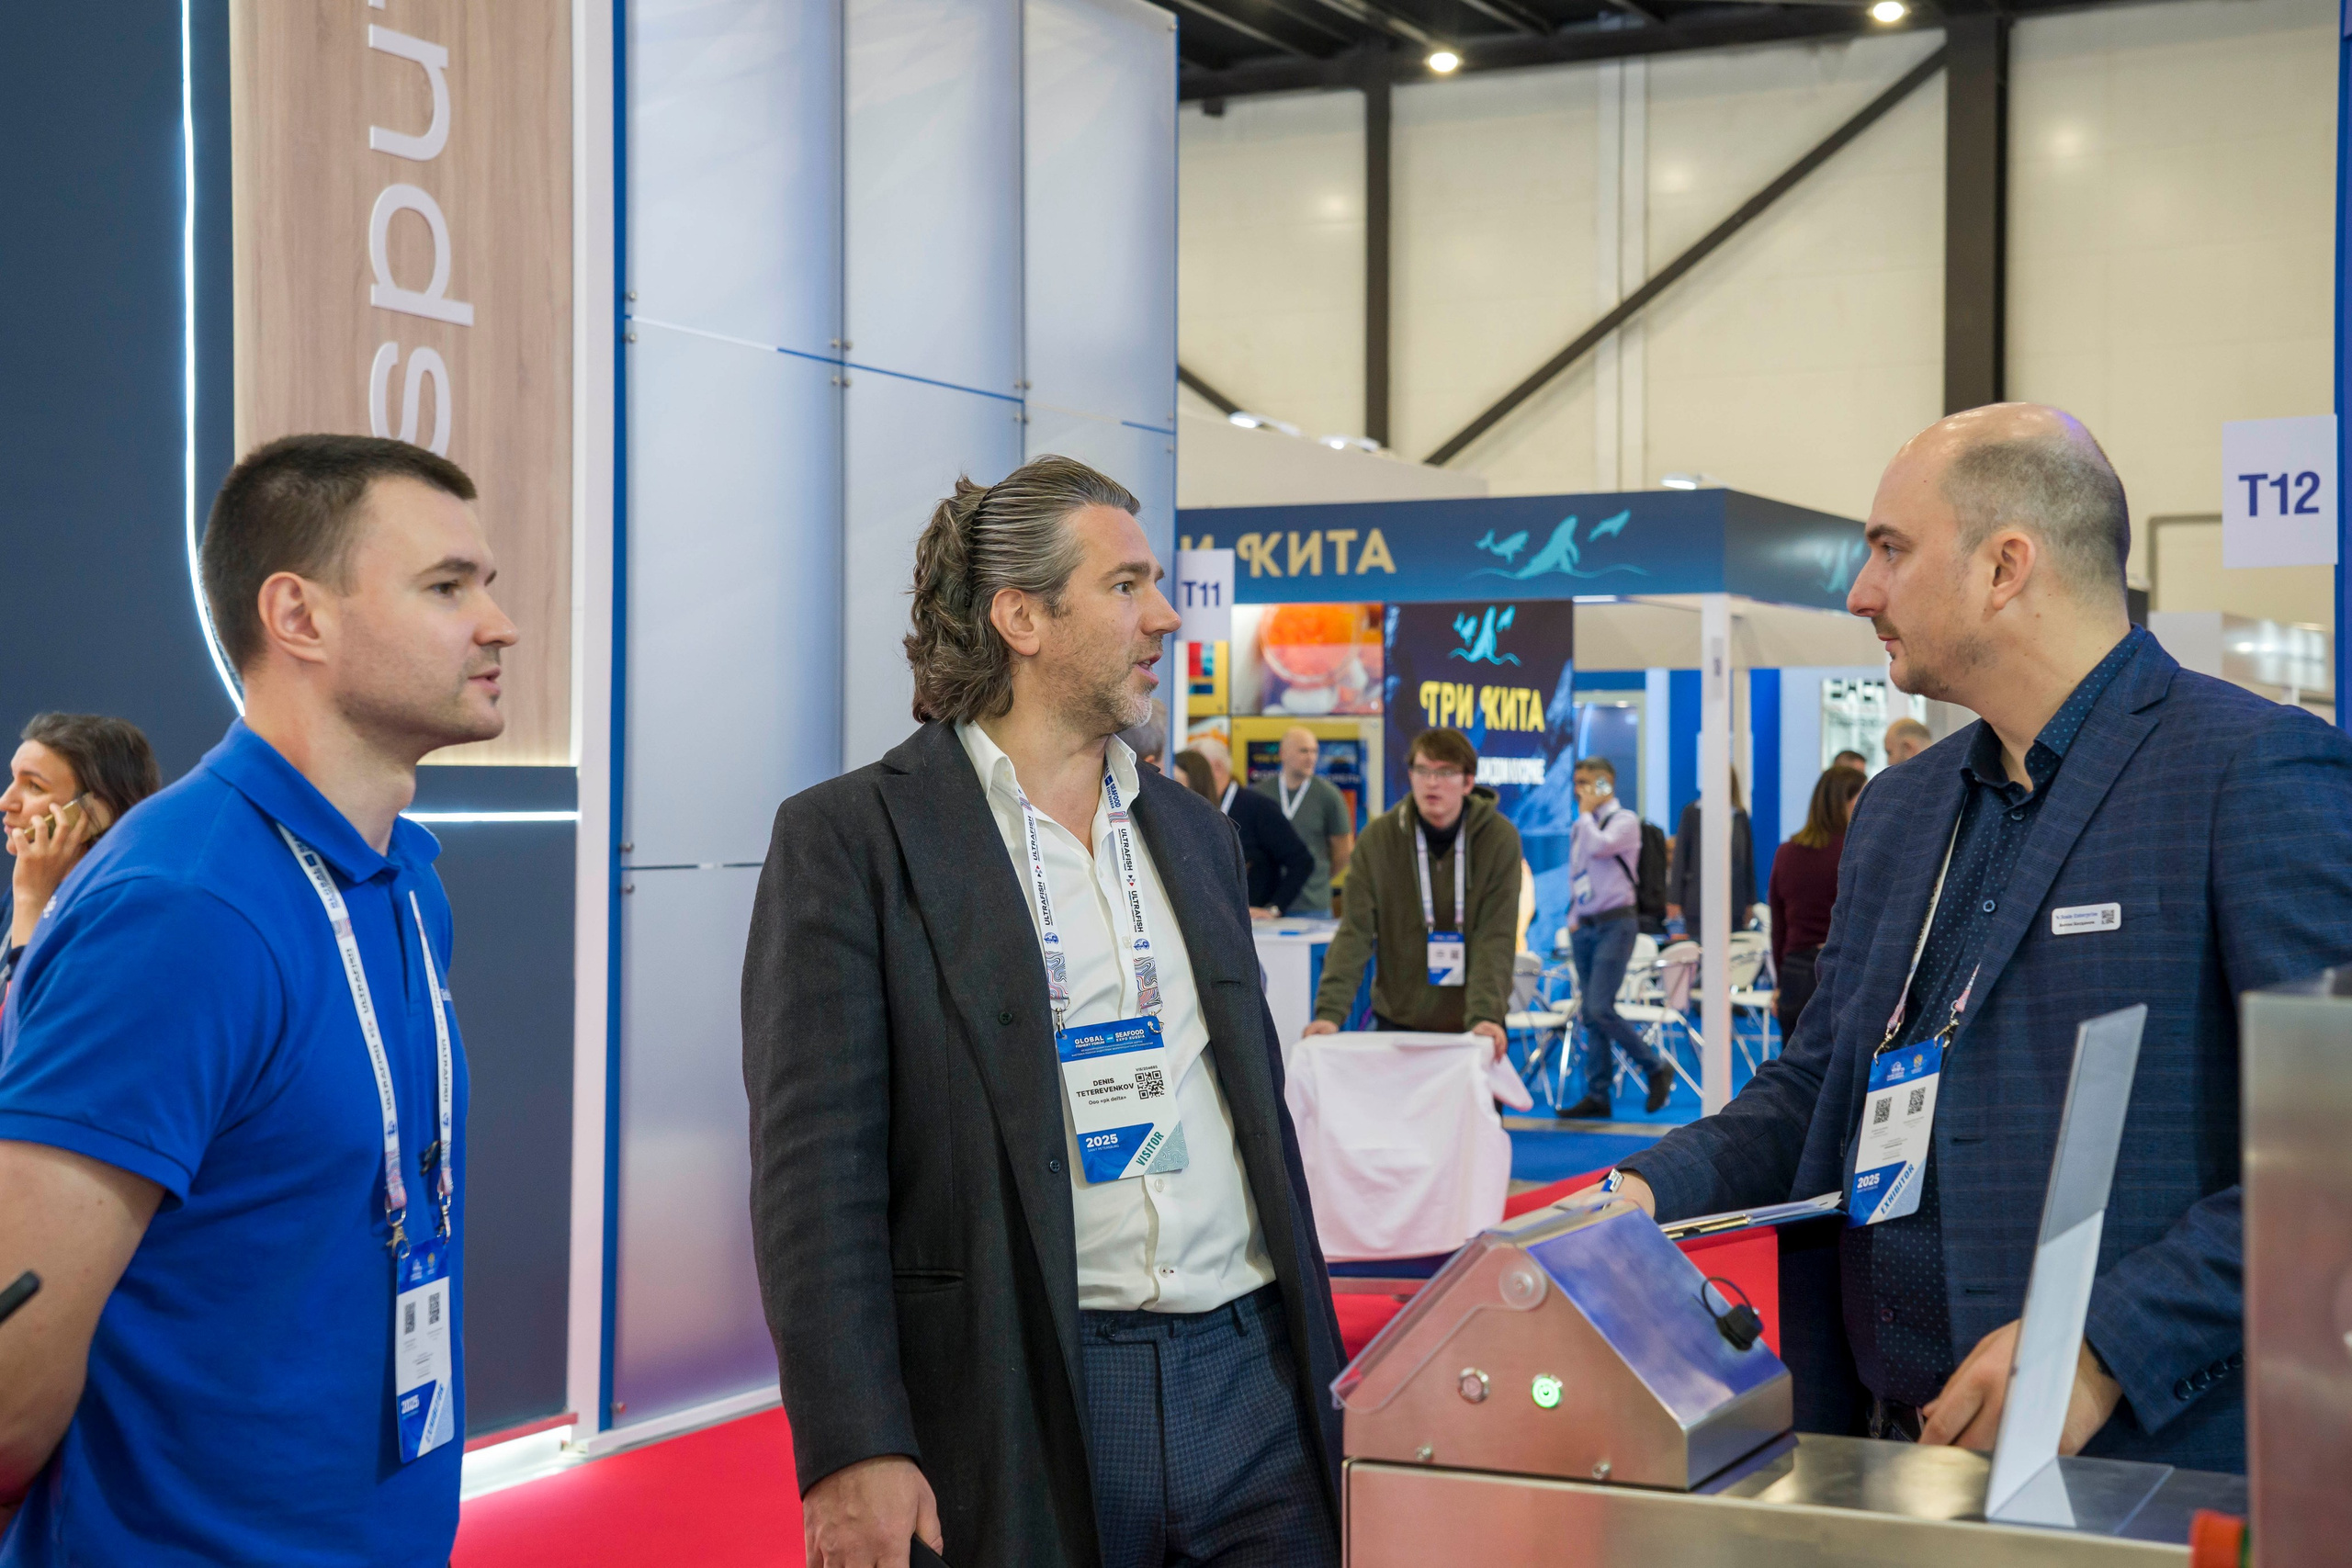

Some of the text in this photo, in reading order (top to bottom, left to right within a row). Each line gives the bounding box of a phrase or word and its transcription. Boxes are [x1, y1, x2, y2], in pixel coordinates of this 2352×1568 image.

[369, 0, 474, 458] nds
[2238, 471, 2321, 516] T12
[1236, 527, 1397, 578] КИТА
[1182, 581, 1220, 607] T11
[1419, 681, 1545, 733] ТРИ КИТА
[1110, 784, 1121, 807] SEAFOOD
[1027, 816, 1038, 861] ULTRAFISH
[1121, 829, 1134, 871] ULTRAFISH
[1037, 881, 1050, 926] ULTRAFISH
[1131, 890, 1144, 933] ULTRAFISH
[1075, 1036, 1103, 1044] GLOBAL
[1114, 1029, 1145, 1039] SEAFOOD
[1076, 1083, 1135, 1098] TETEREVENKOV
[1092, 1077, 1114, 1087] DENIS
[1085, 1134, 1118, 1148] 2025
[1136, 1131, 1164, 1167] VISITOR
[1857, 1173, 1880, 1189] 2025
[1881, 1164, 1914, 1214] EXHIBITOR
